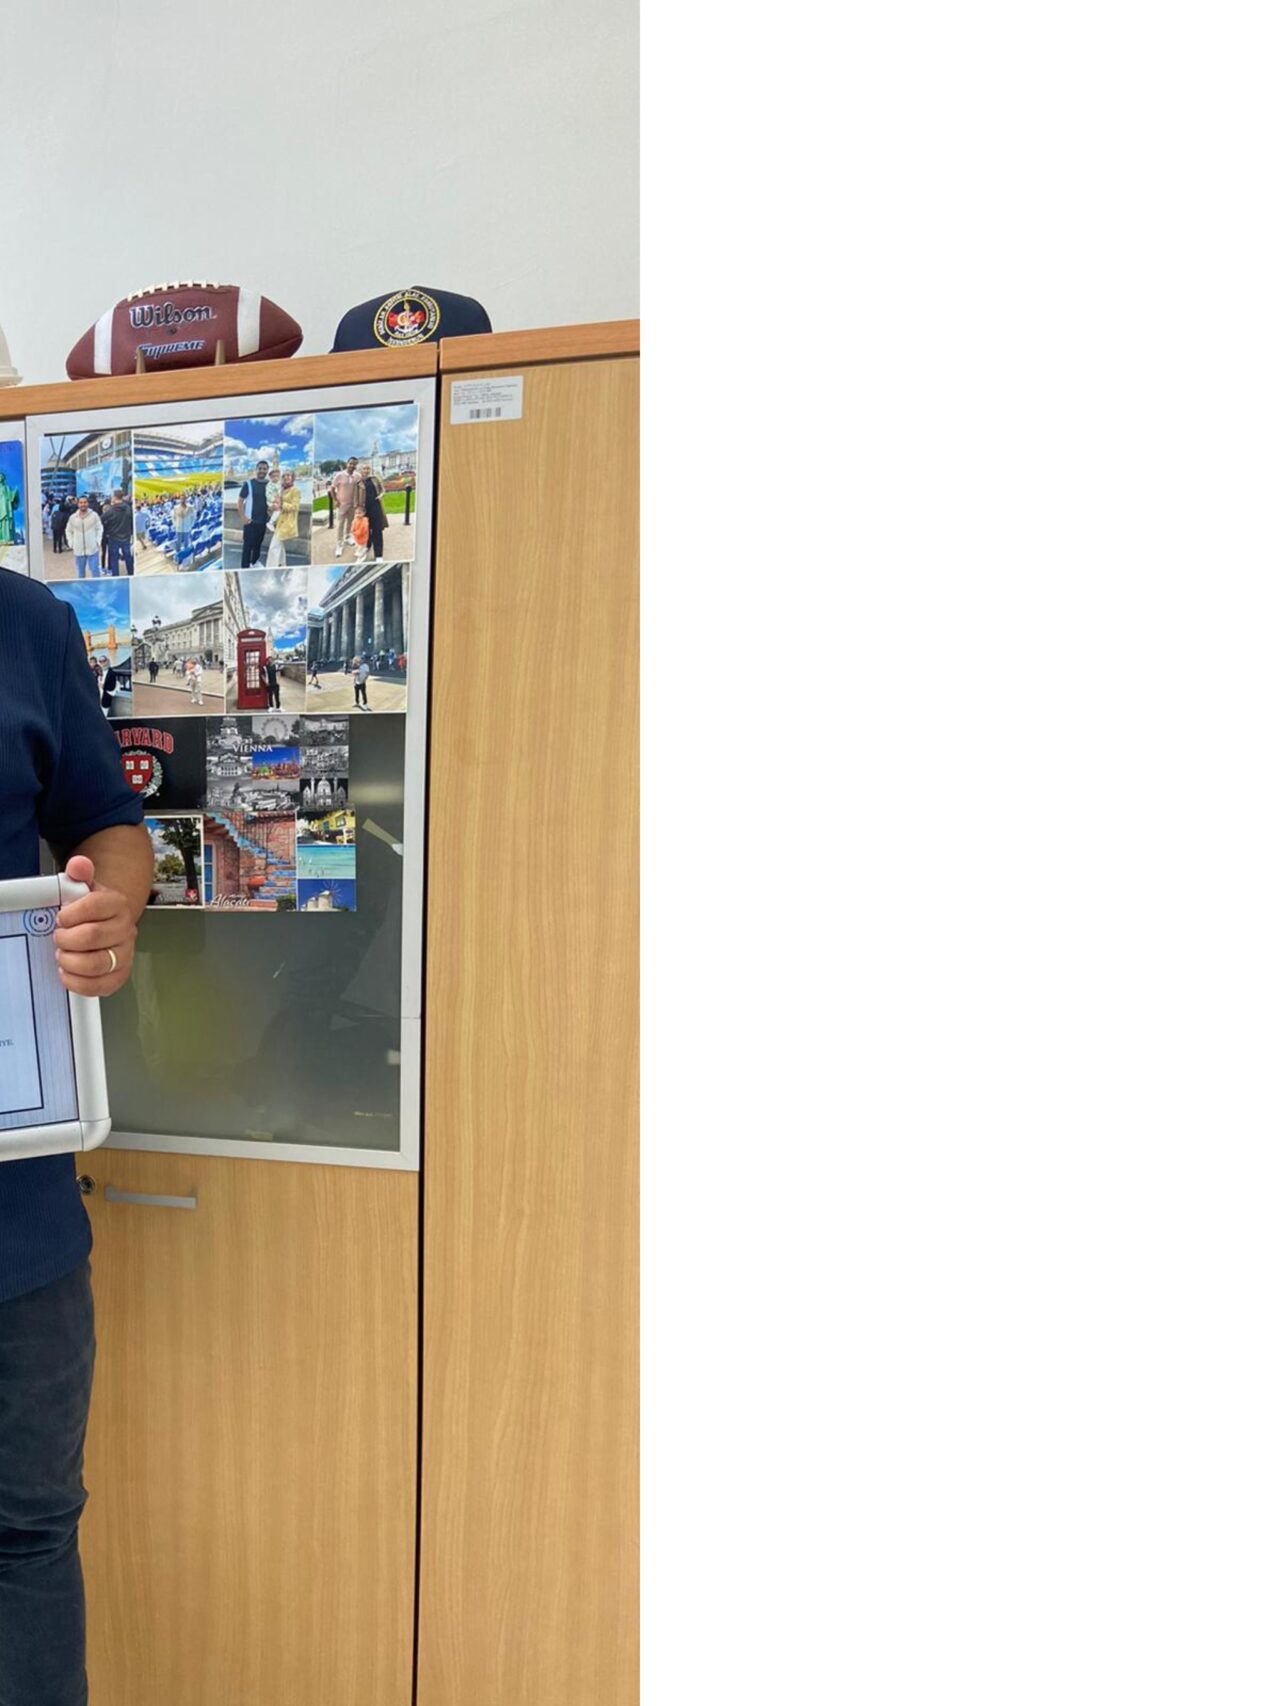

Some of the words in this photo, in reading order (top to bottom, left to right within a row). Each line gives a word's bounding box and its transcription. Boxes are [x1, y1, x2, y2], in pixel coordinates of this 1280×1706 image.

[129, 302, 213, 328] Wilson
[114, 727, 174, 754] RVARD
[232, 744, 273, 753] VIENNA
